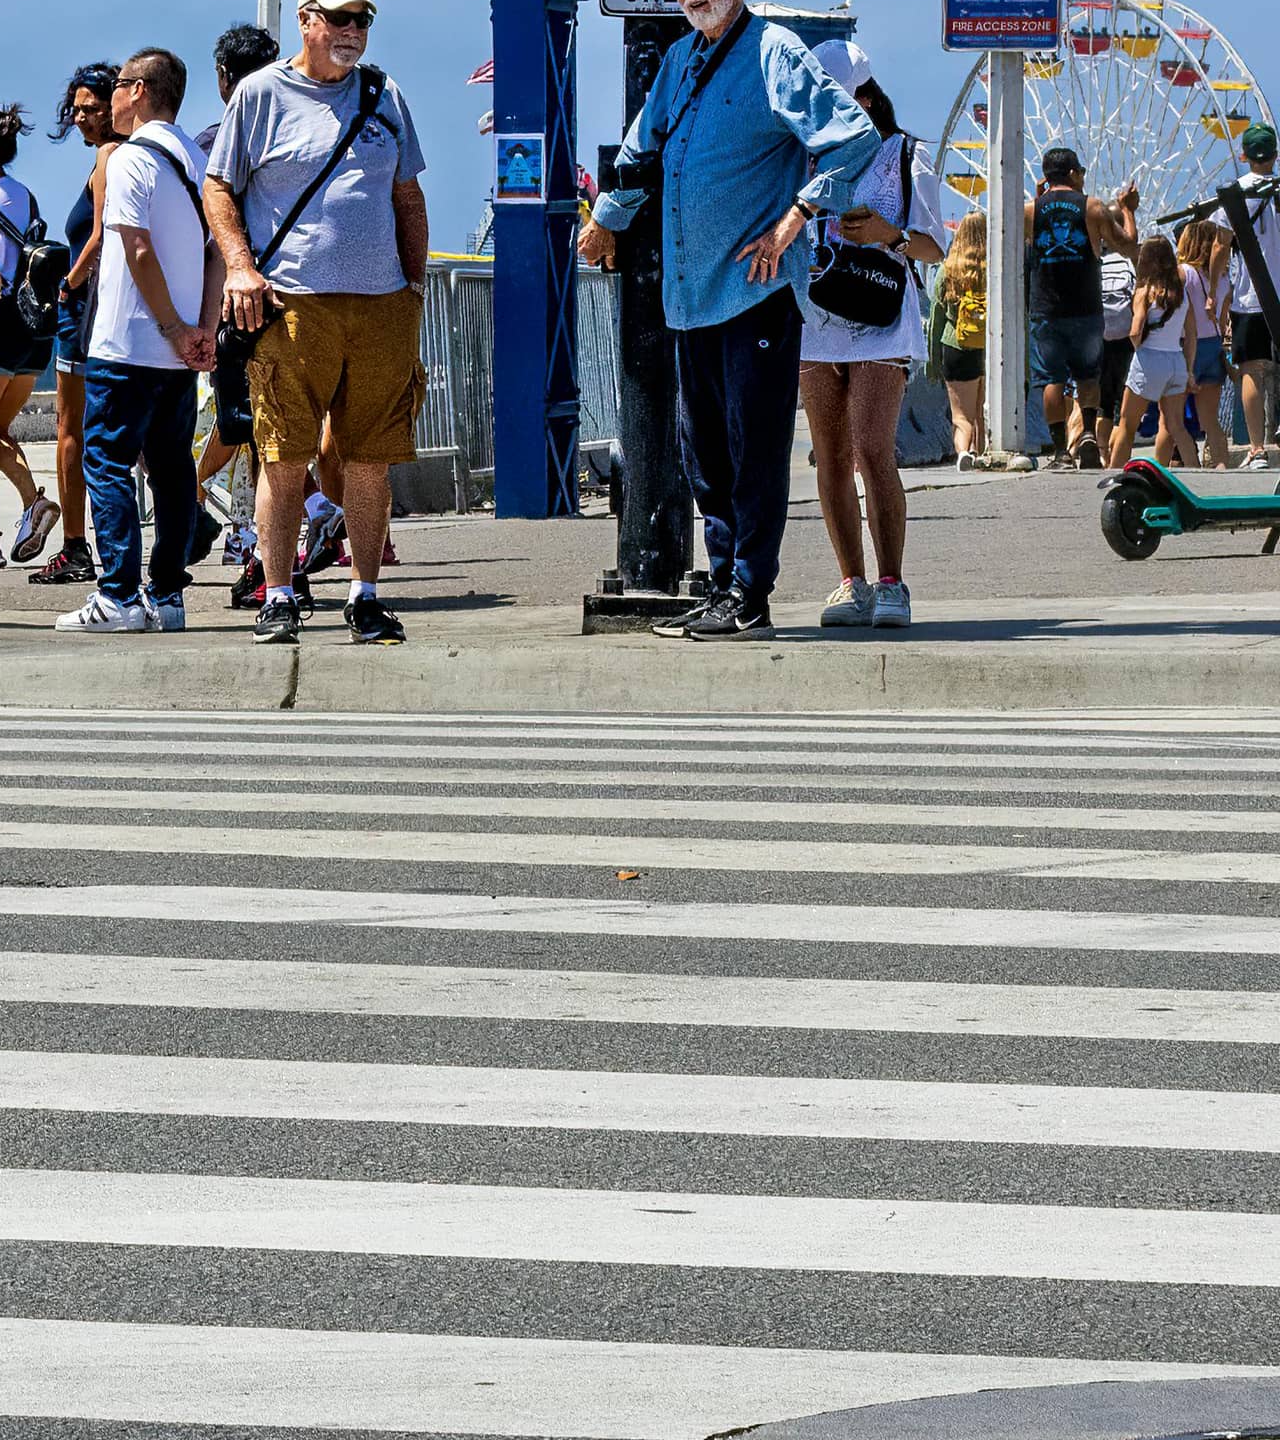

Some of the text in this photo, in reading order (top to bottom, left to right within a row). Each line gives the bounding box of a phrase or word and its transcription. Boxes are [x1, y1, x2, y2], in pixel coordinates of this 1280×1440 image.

[952, 20, 1051, 31] FIRE ACCESS ZONE
